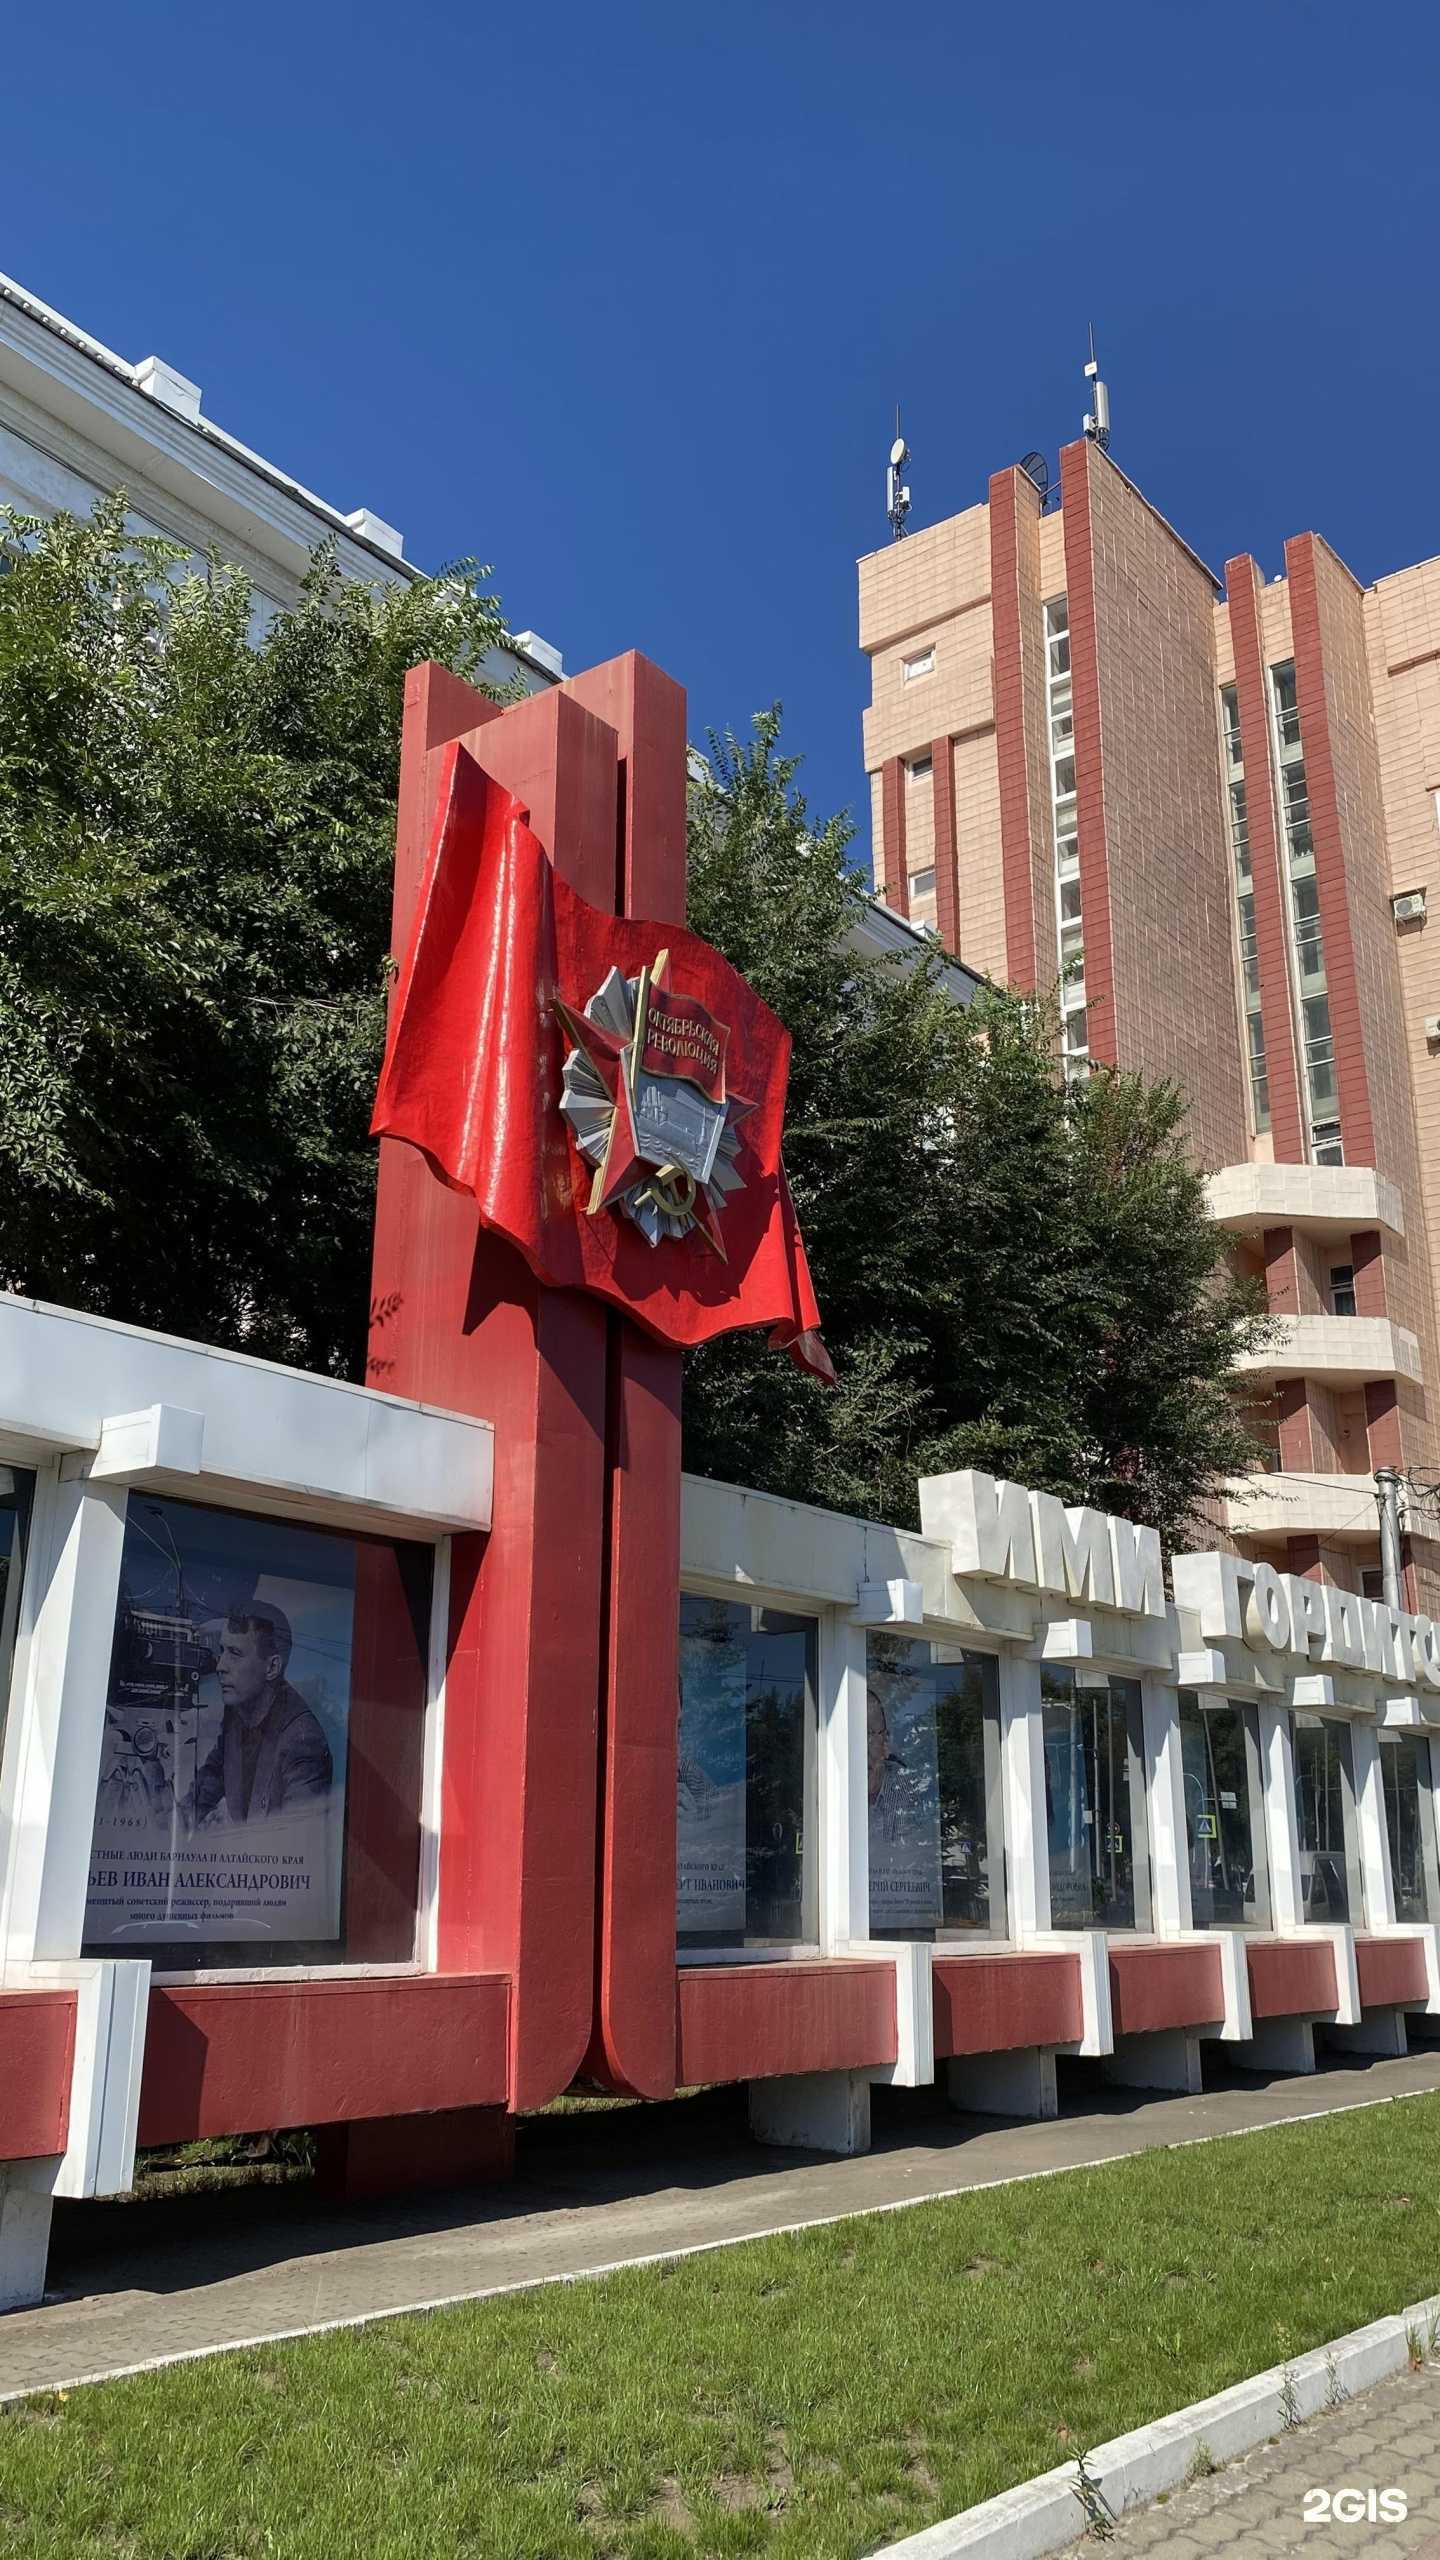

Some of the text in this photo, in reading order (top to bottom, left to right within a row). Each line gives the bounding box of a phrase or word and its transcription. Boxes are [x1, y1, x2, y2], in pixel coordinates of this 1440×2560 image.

[647, 1028, 718, 1074] РЕВОЛЮЦИЯ
[648, 1007, 719, 1056] ОКТЯБРЬСКАЯ
[919, 1469, 1167, 1619] ИМИ
[123, 1871, 169, 1888] ИВАН
[175, 1872, 312, 1891] АЛЕКСАНДРОВИЧ
[128, 1851, 157, 1862] ЛЮДИ
[161, 1852, 207, 1863] БАРНАУЛА
[210, 1853, 217, 1863] И
[220, 1852, 279, 1864] АЛТАЙСКОГО
[282, 1855, 304, 1865] КРАЯ
